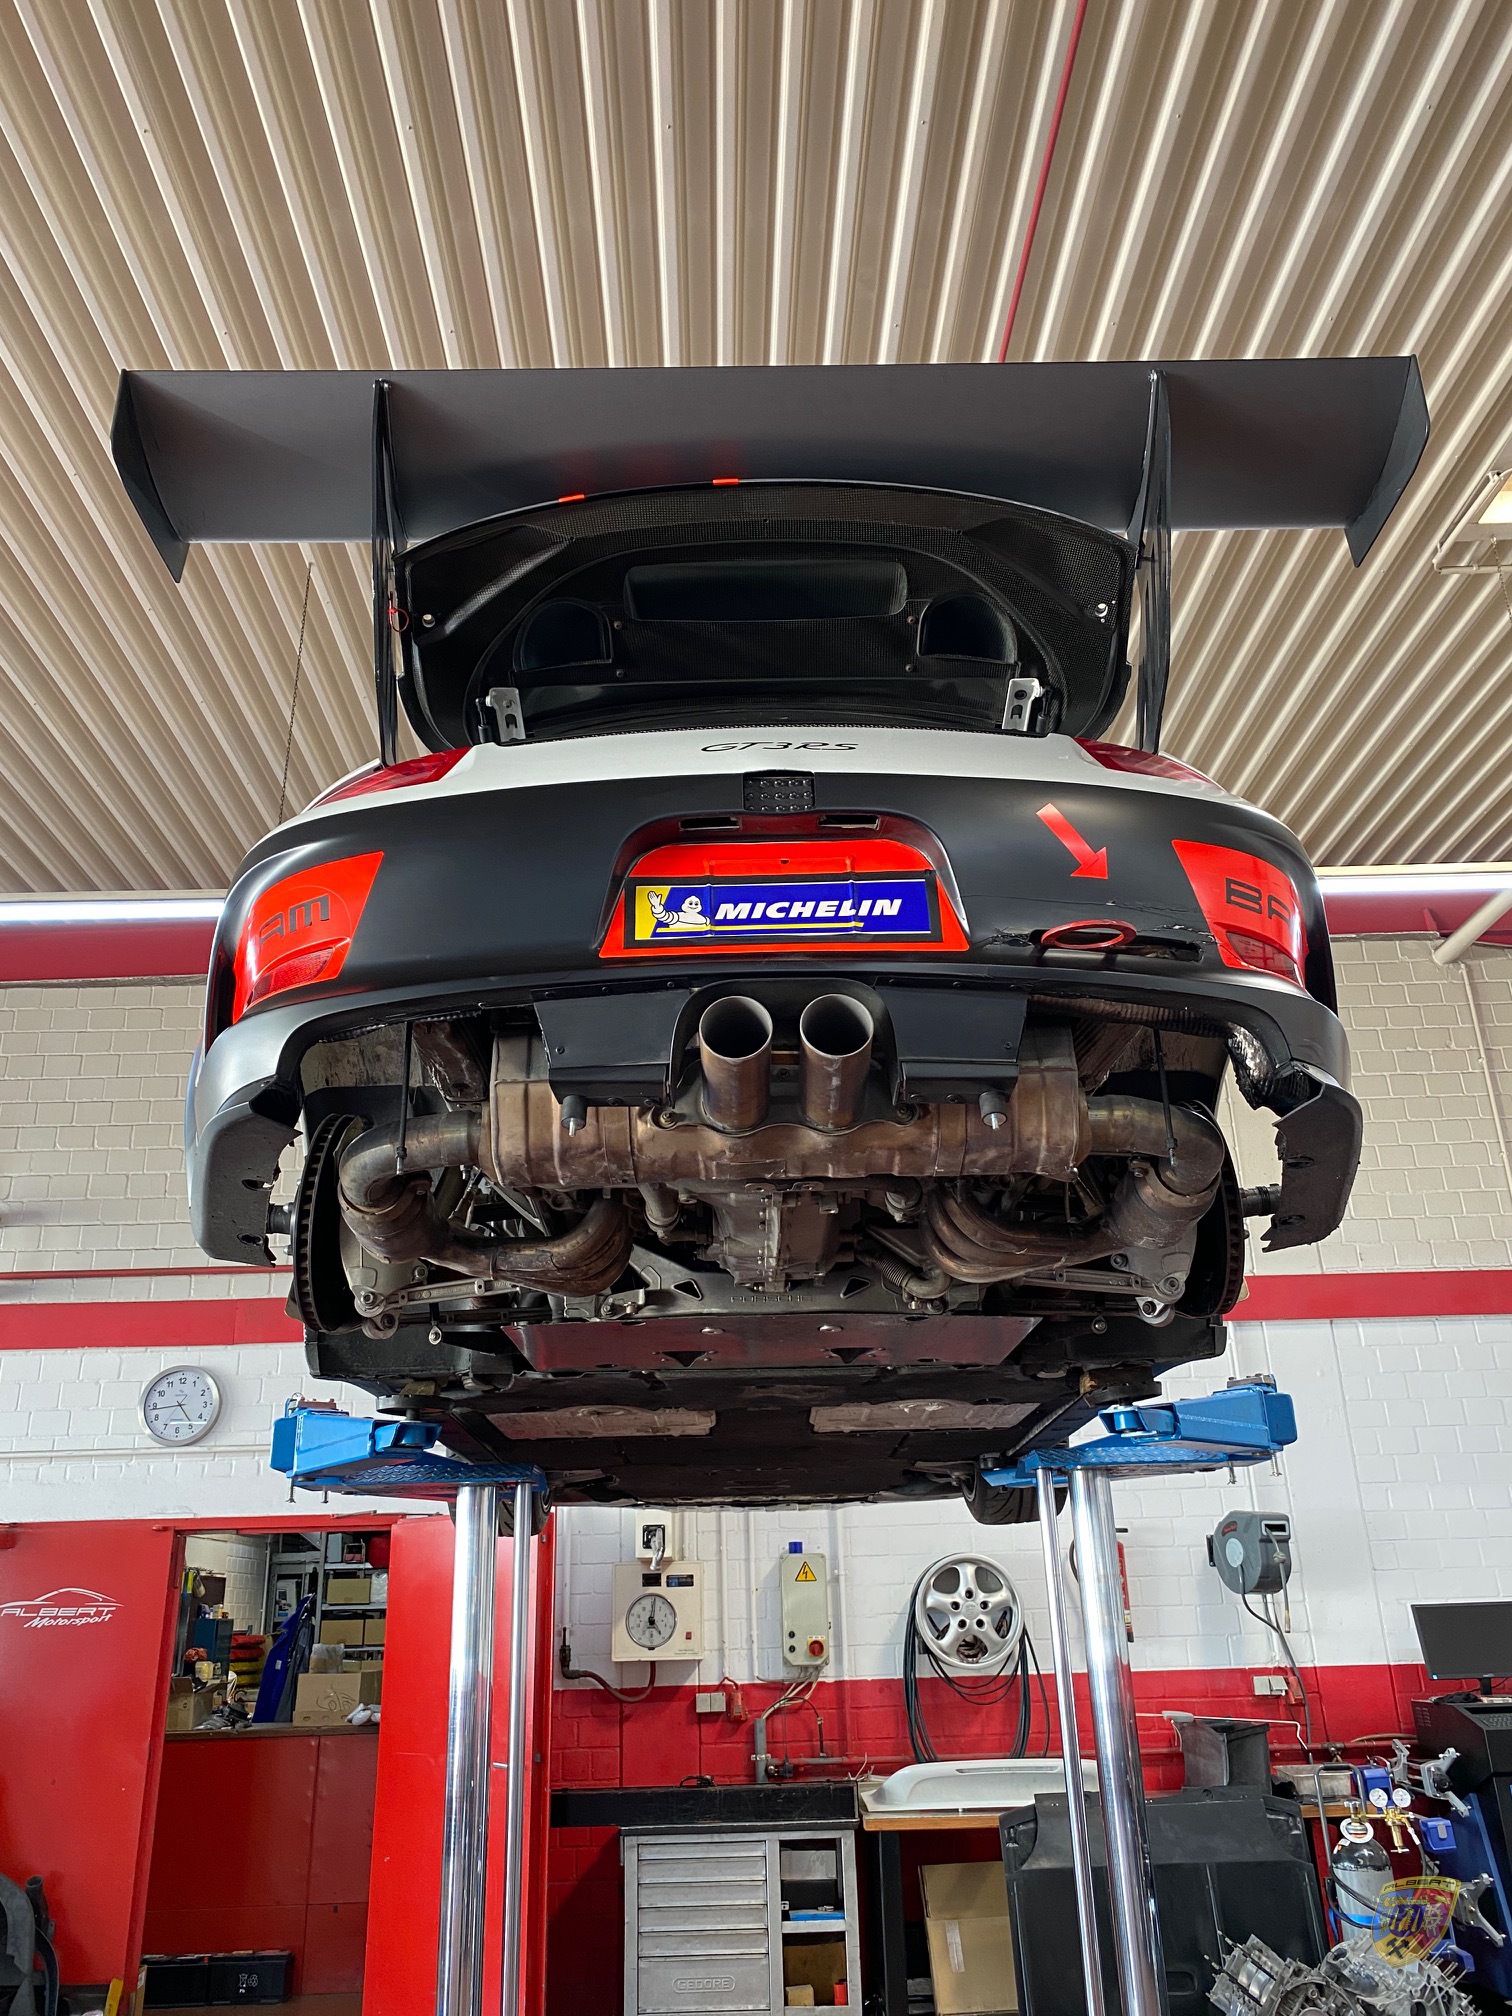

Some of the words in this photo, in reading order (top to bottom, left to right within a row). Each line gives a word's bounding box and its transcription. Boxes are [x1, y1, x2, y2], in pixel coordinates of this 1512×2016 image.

[714, 898, 903, 920] MICHELIN
[197, 1412, 203, 1420] 4
[1, 1607, 116, 1616] ALBERT
[23, 1613, 113, 1628] Motorsport
[677, 1978, 730, 1991] GEDORE
